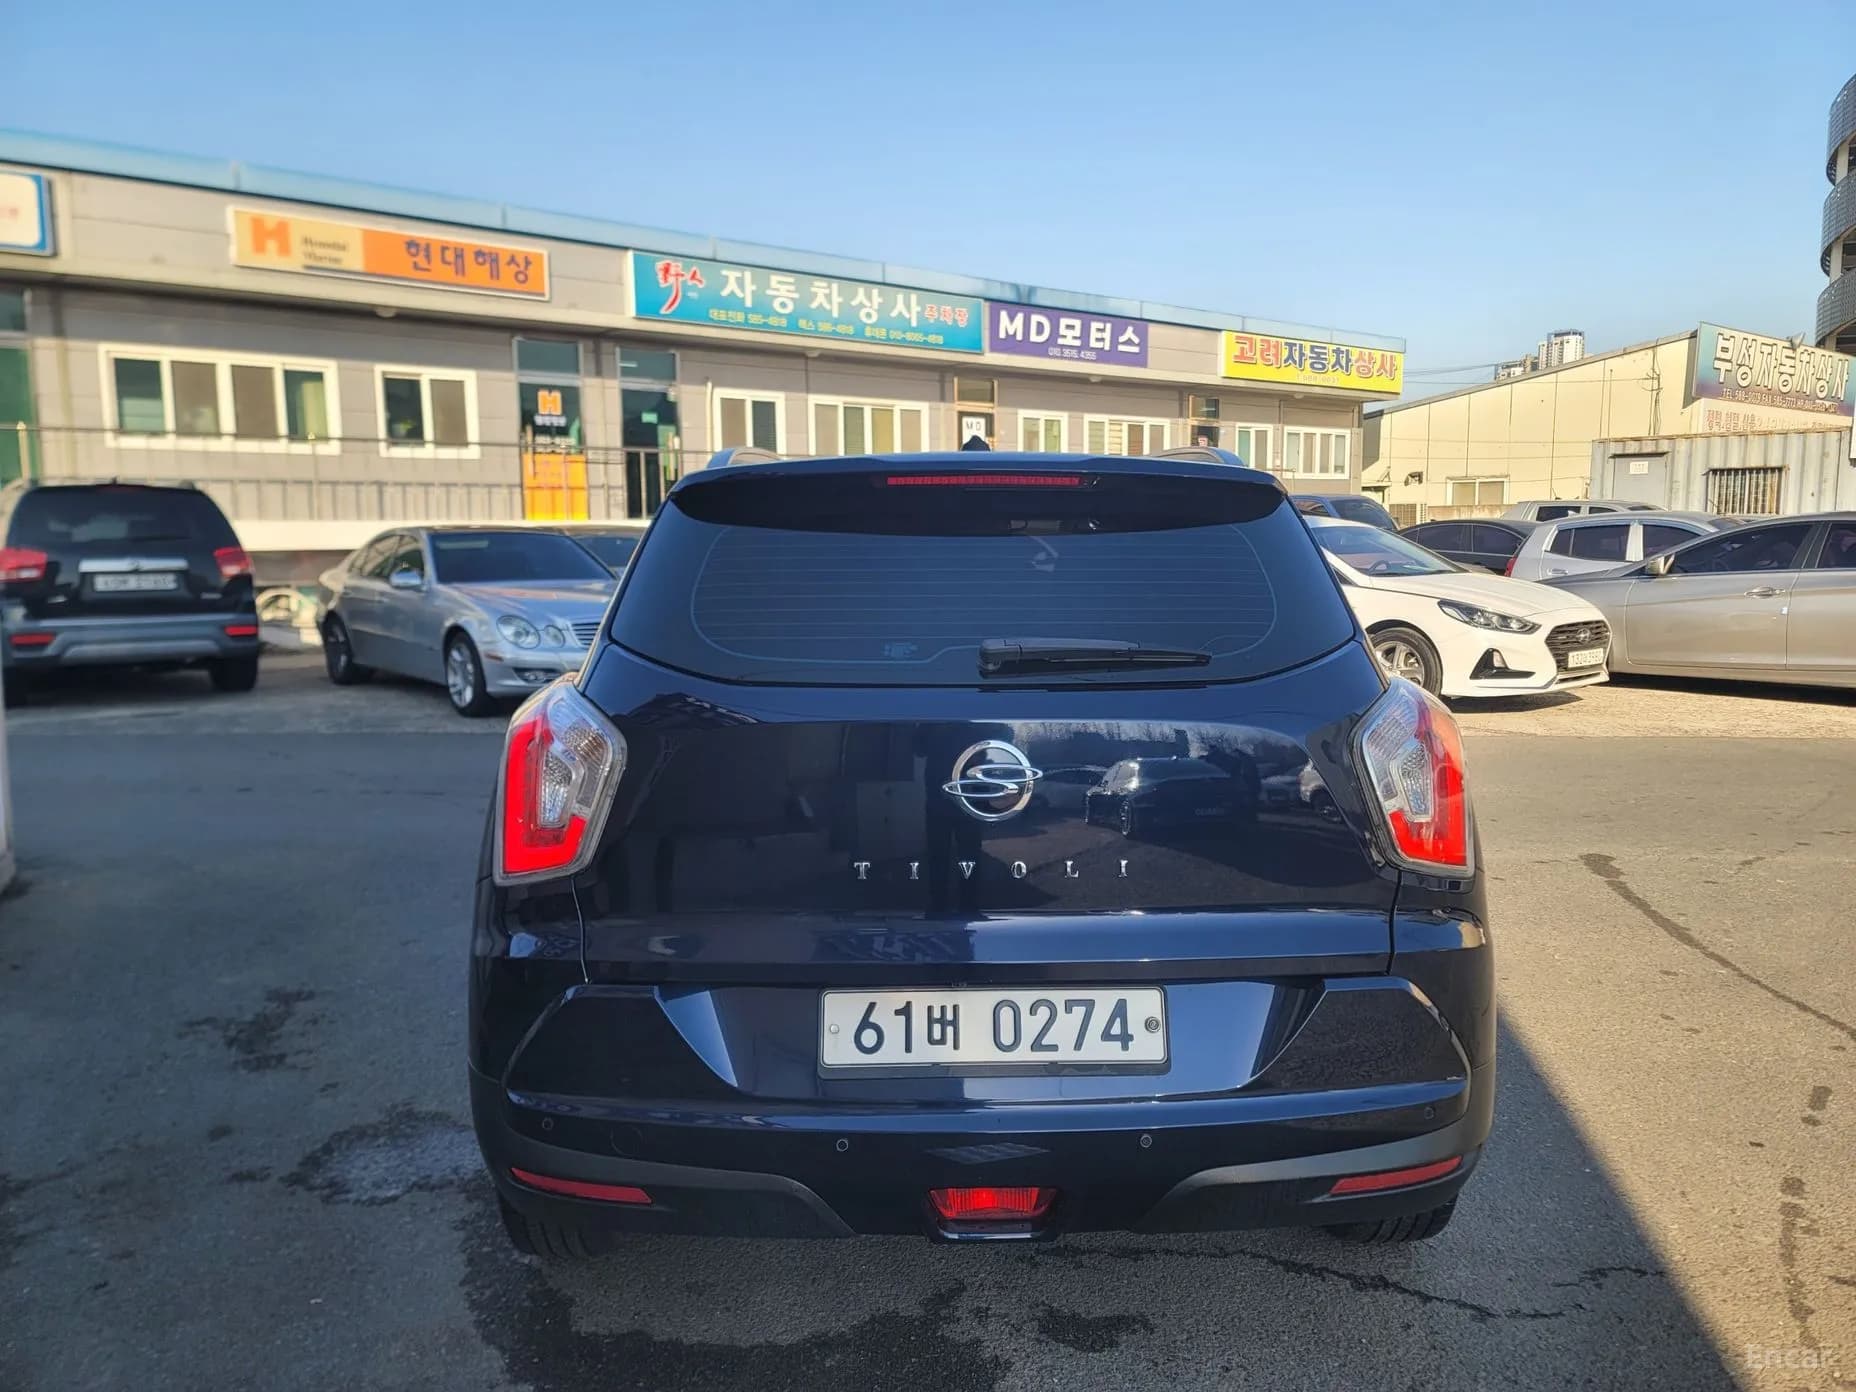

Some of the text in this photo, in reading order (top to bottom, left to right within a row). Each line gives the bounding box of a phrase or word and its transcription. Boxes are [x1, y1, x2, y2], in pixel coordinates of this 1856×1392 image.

[405, 239, 531, 284] 현대해상
[720, 268, 921, 327] 자동차상사
[1233, 335, 1397, 379] 고려자동차상사
[1713, 332, 1849, 400] 부성자동차상사
[854, 859, 1128, 880] TIVOLI
[853, 998, 1134, 1055] 61버 0274
